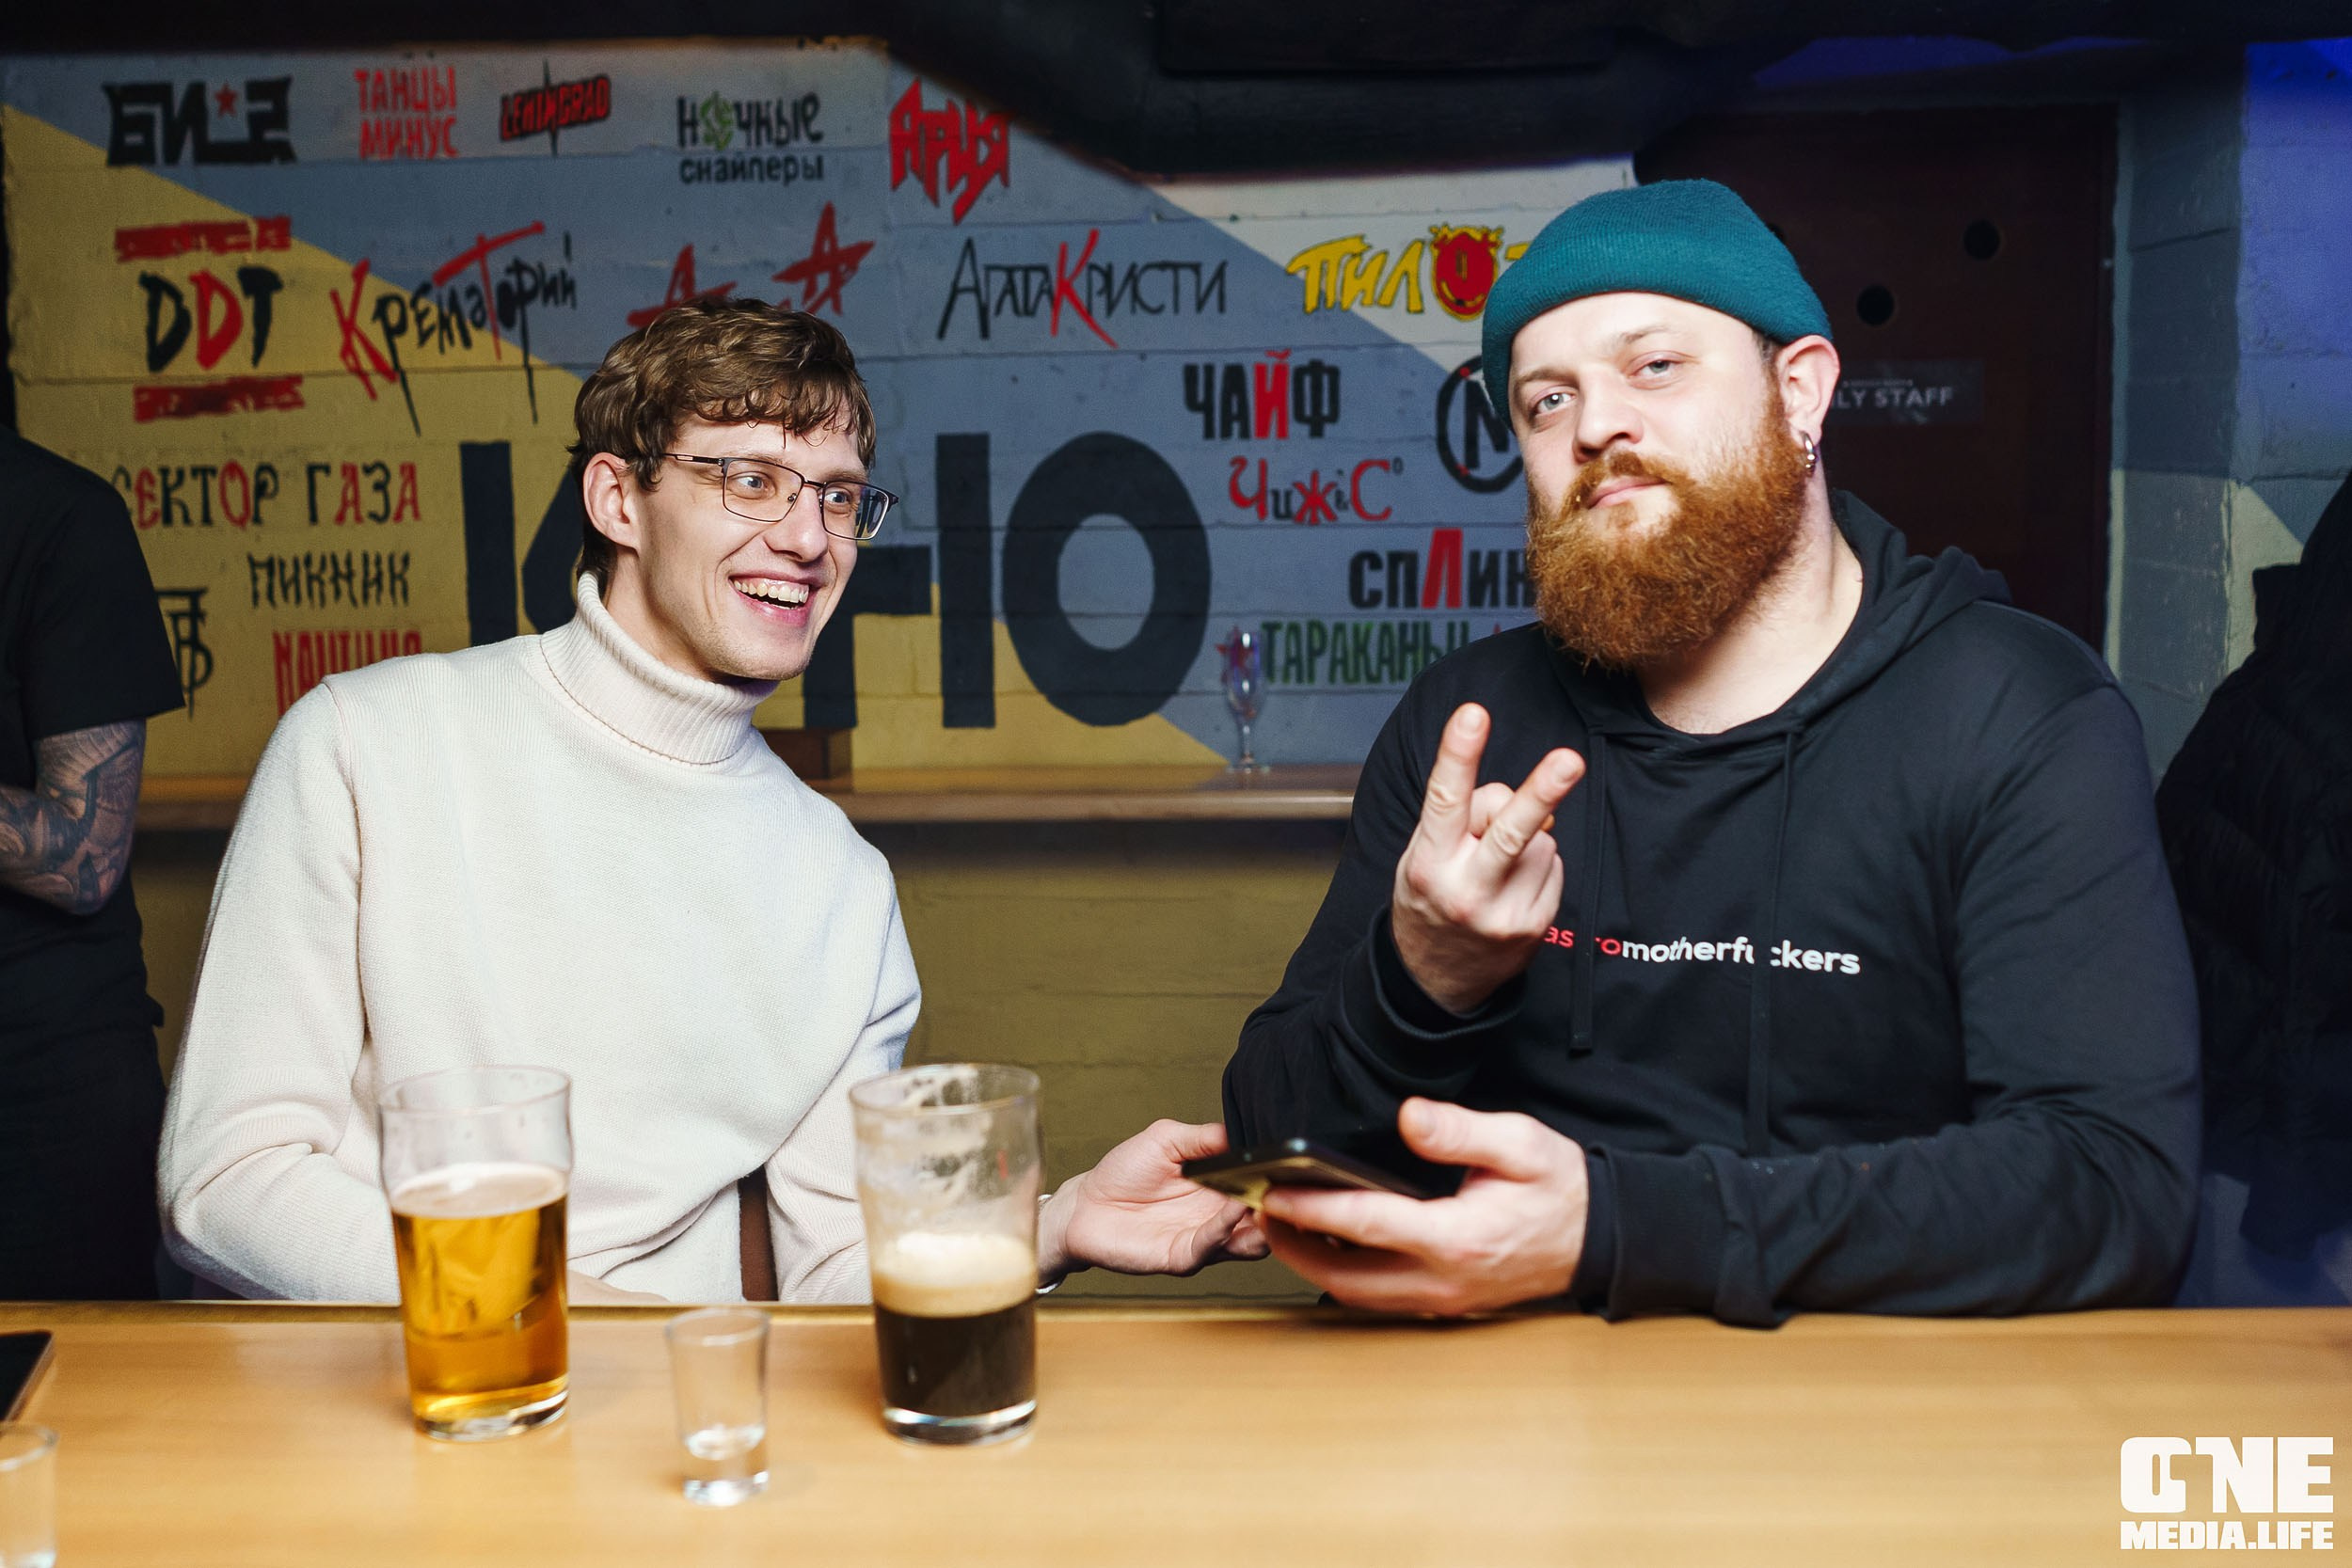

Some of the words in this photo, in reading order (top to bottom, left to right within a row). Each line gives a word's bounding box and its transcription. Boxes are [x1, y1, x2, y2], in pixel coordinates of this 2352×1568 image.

[355, 66, 456, 113] ТАНЦЫ
[501, 76, 610, 141] LENINGRAD
[359, 117, 458, 160] МИНУС
[679, 154, 825, 185] снайперы
[1286, 220, 1532, 322] ПИЛО
[1184, 349, 1341, 439] ЧАЙФ
[1875, 386, 1953, 407] STAFF
[306, 461, 421, 527] ГАЗА
